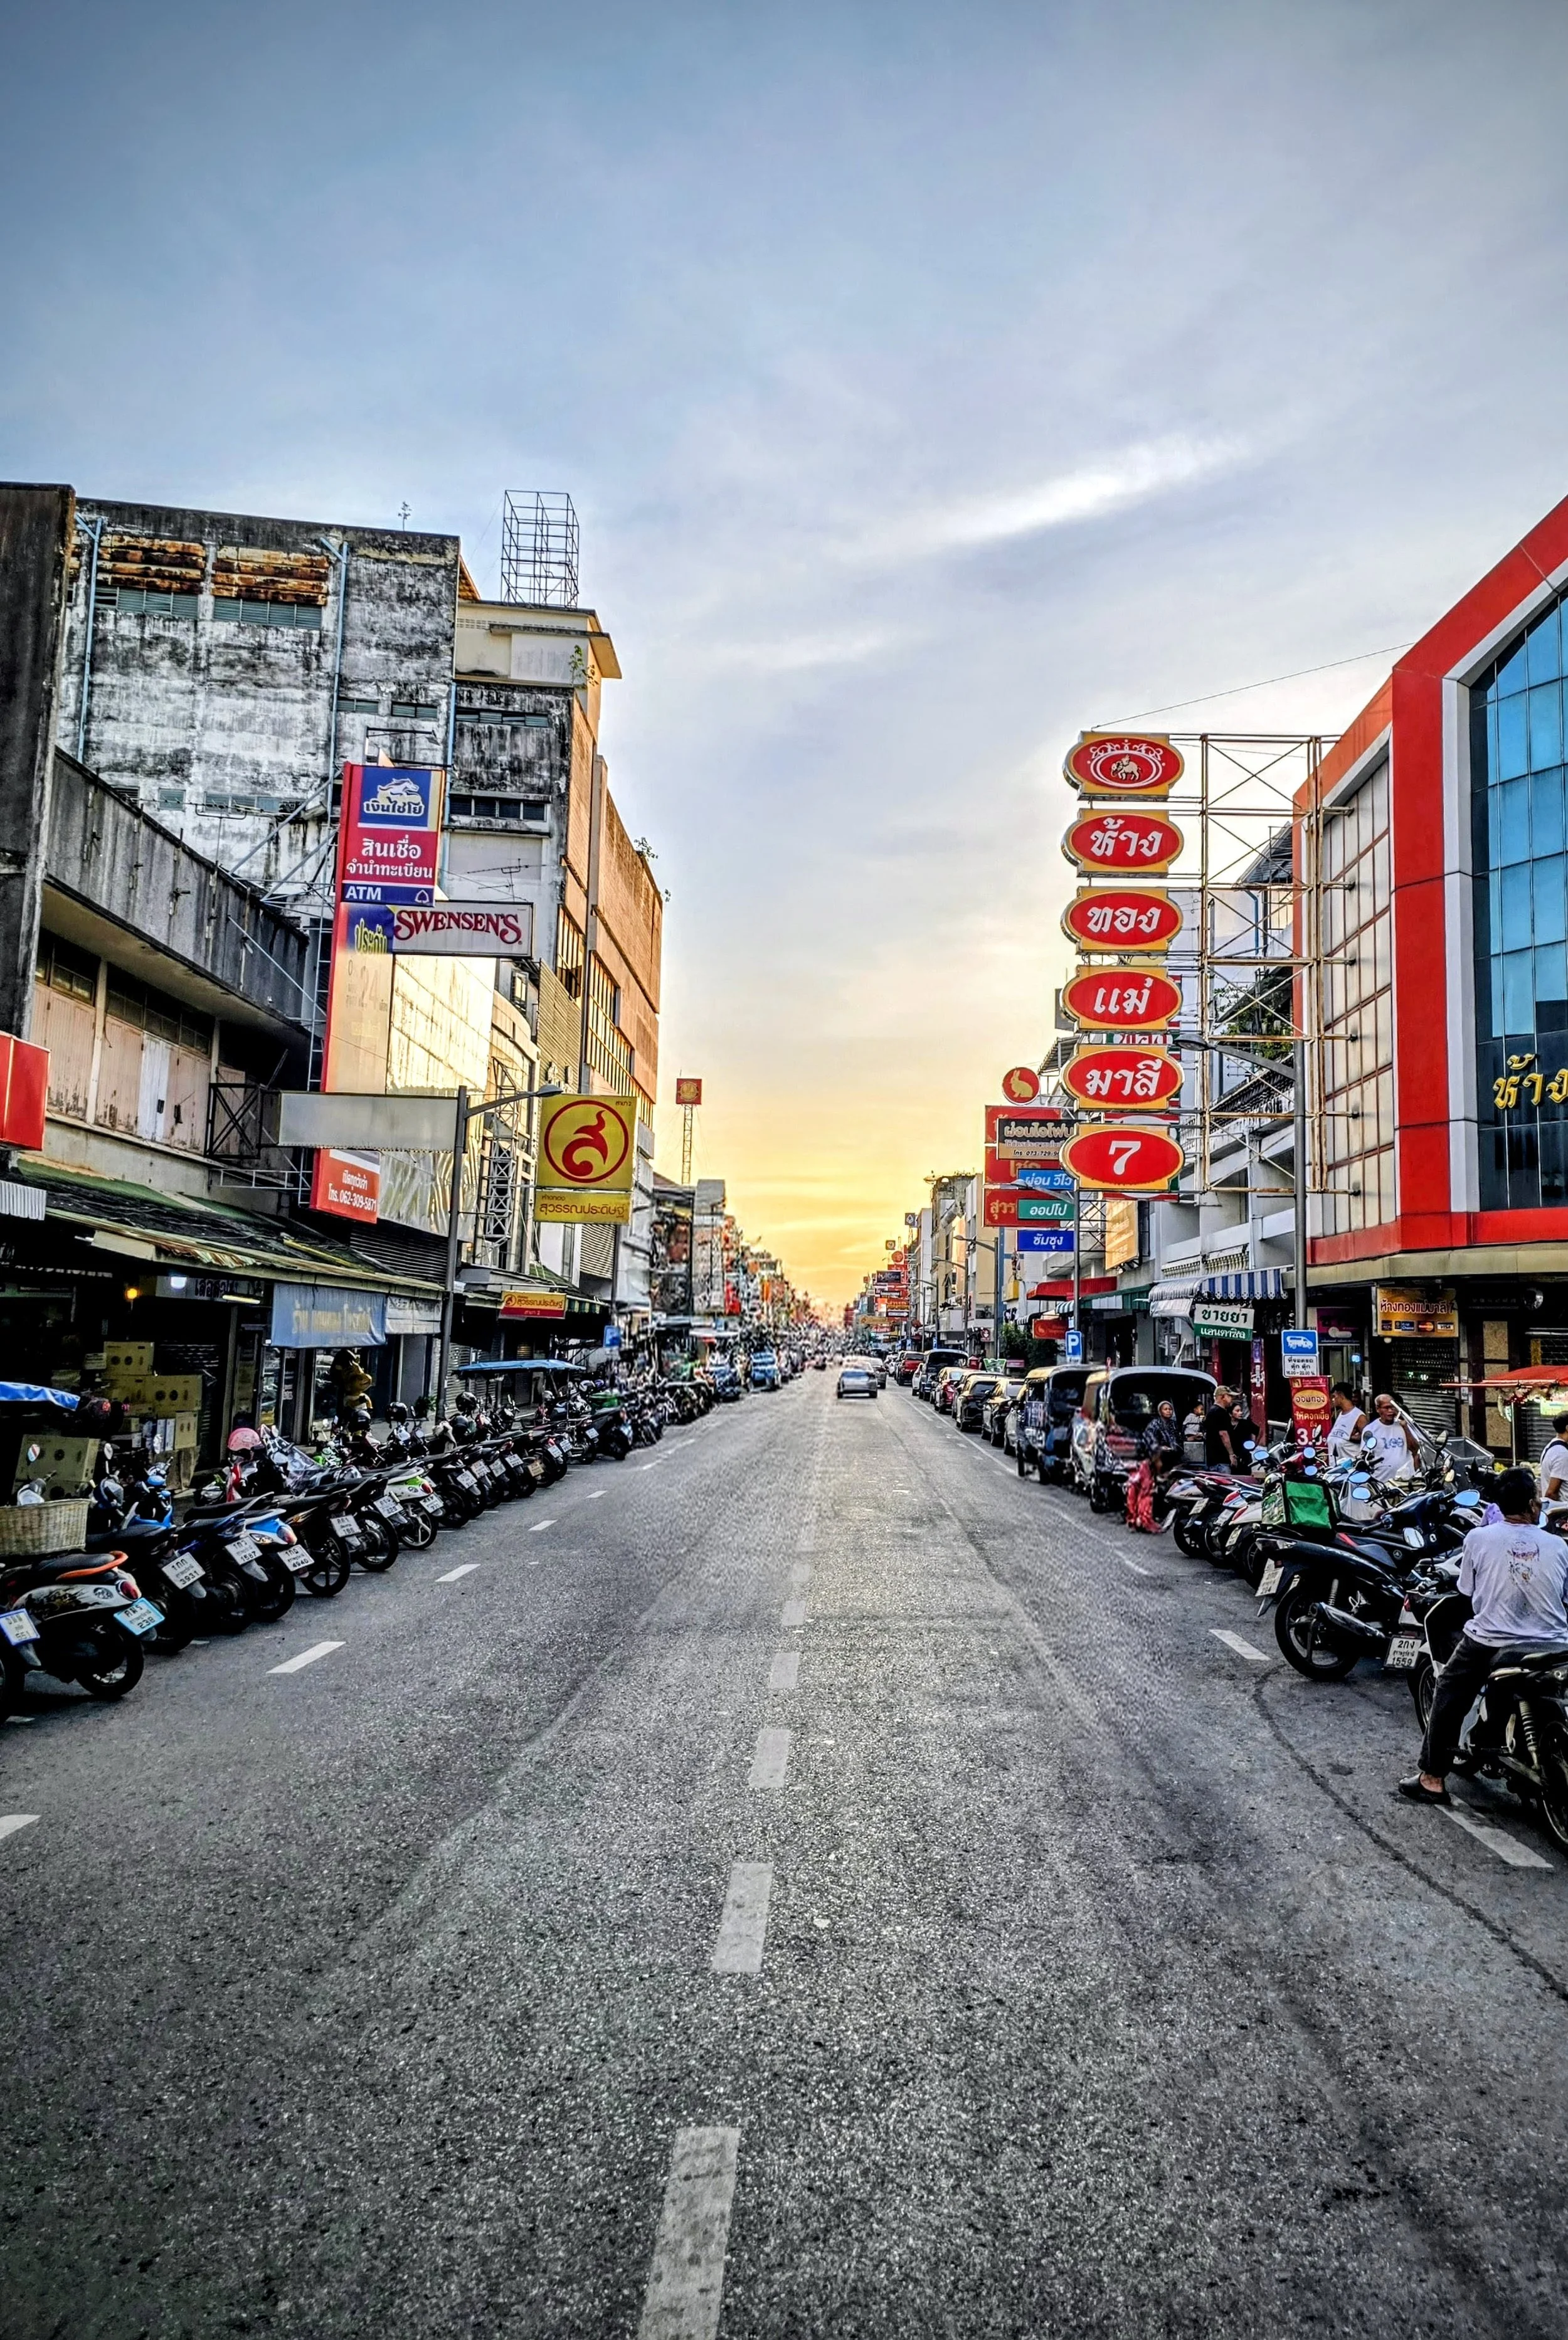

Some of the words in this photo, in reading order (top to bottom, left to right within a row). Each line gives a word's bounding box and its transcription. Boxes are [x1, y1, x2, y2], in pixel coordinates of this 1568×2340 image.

[365, 797, 423, 815] เงินไชโย
[361, 835, 421, 859] สินเชื่อ
[1090, 817, 1162, 857] ห้าง
[346, 858, 432, 878] จำนำทะเบียน
[346, 886, 381, 901] ATM
[393, 909, 522, 945] SWENSEN'S
[1086, 907, 1161, 933] ทอง
[1094, 976, 1152, 1014] แม่
[1086, 1059, 1163, 1097] มาลี
[1493, 1053, 1568, 1109] ห้าง
[1108, 1141, 1141, 1175] 7
[1032, 1232, 1064, 1249] ซัมซุง
[1202, 1308, 1248, 1323] ขายยา
[1068, 1334, 1079, 1353] P
[1392, 1657, 1412, 1666] 1559
